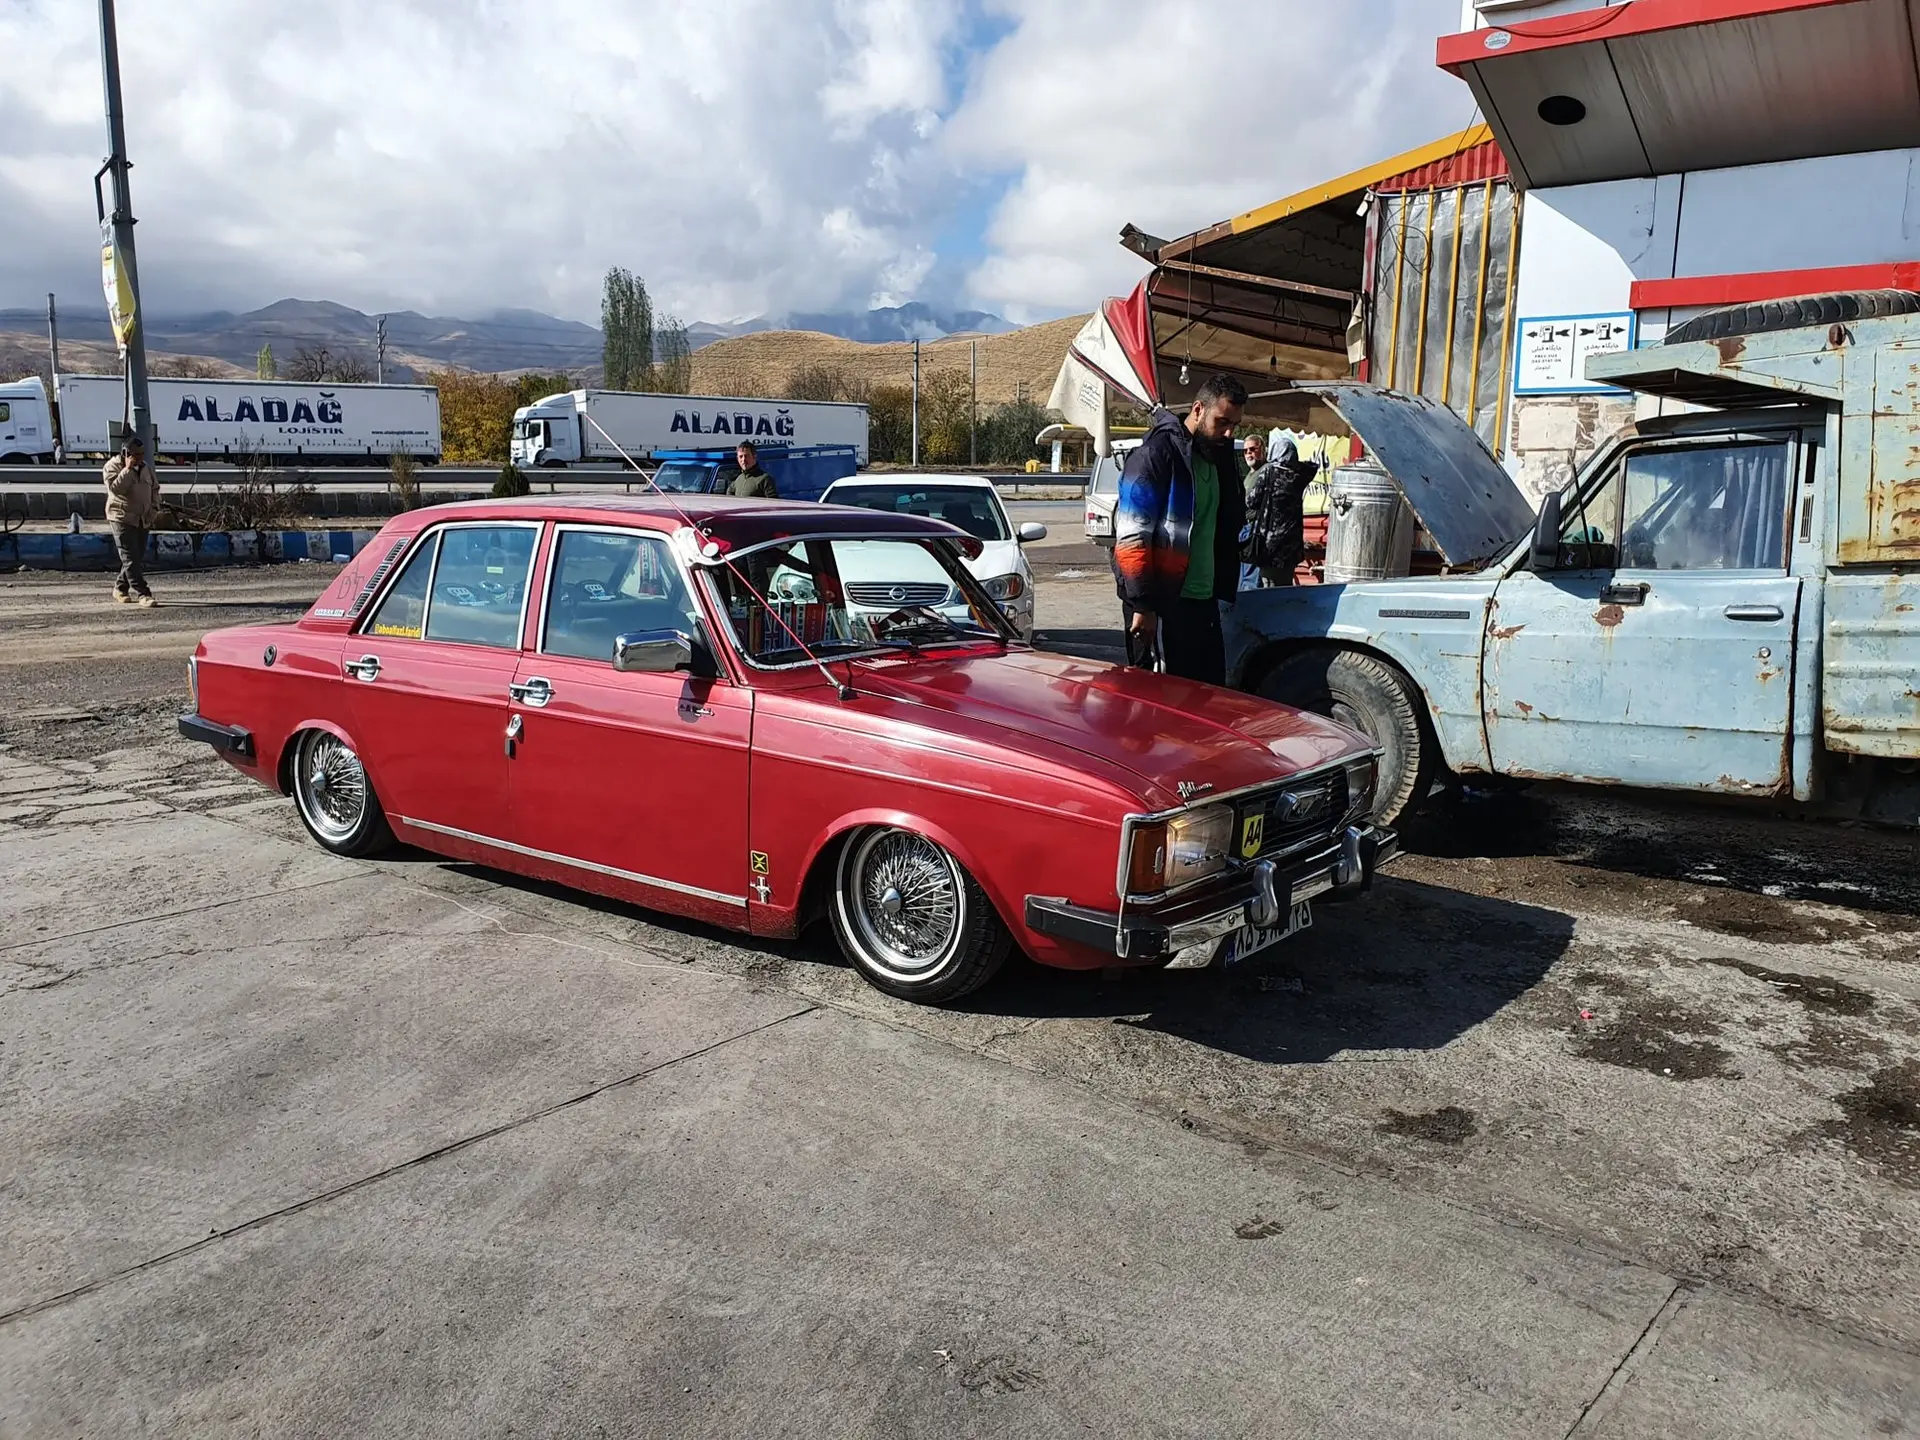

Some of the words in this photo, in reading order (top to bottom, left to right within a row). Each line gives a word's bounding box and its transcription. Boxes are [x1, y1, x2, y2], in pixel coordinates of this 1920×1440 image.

[177, 391, 343, 424] ALADAĞ
[670, 408, 795, 437] ALADAĞ
[1244, 818, 1262, 848] AA
